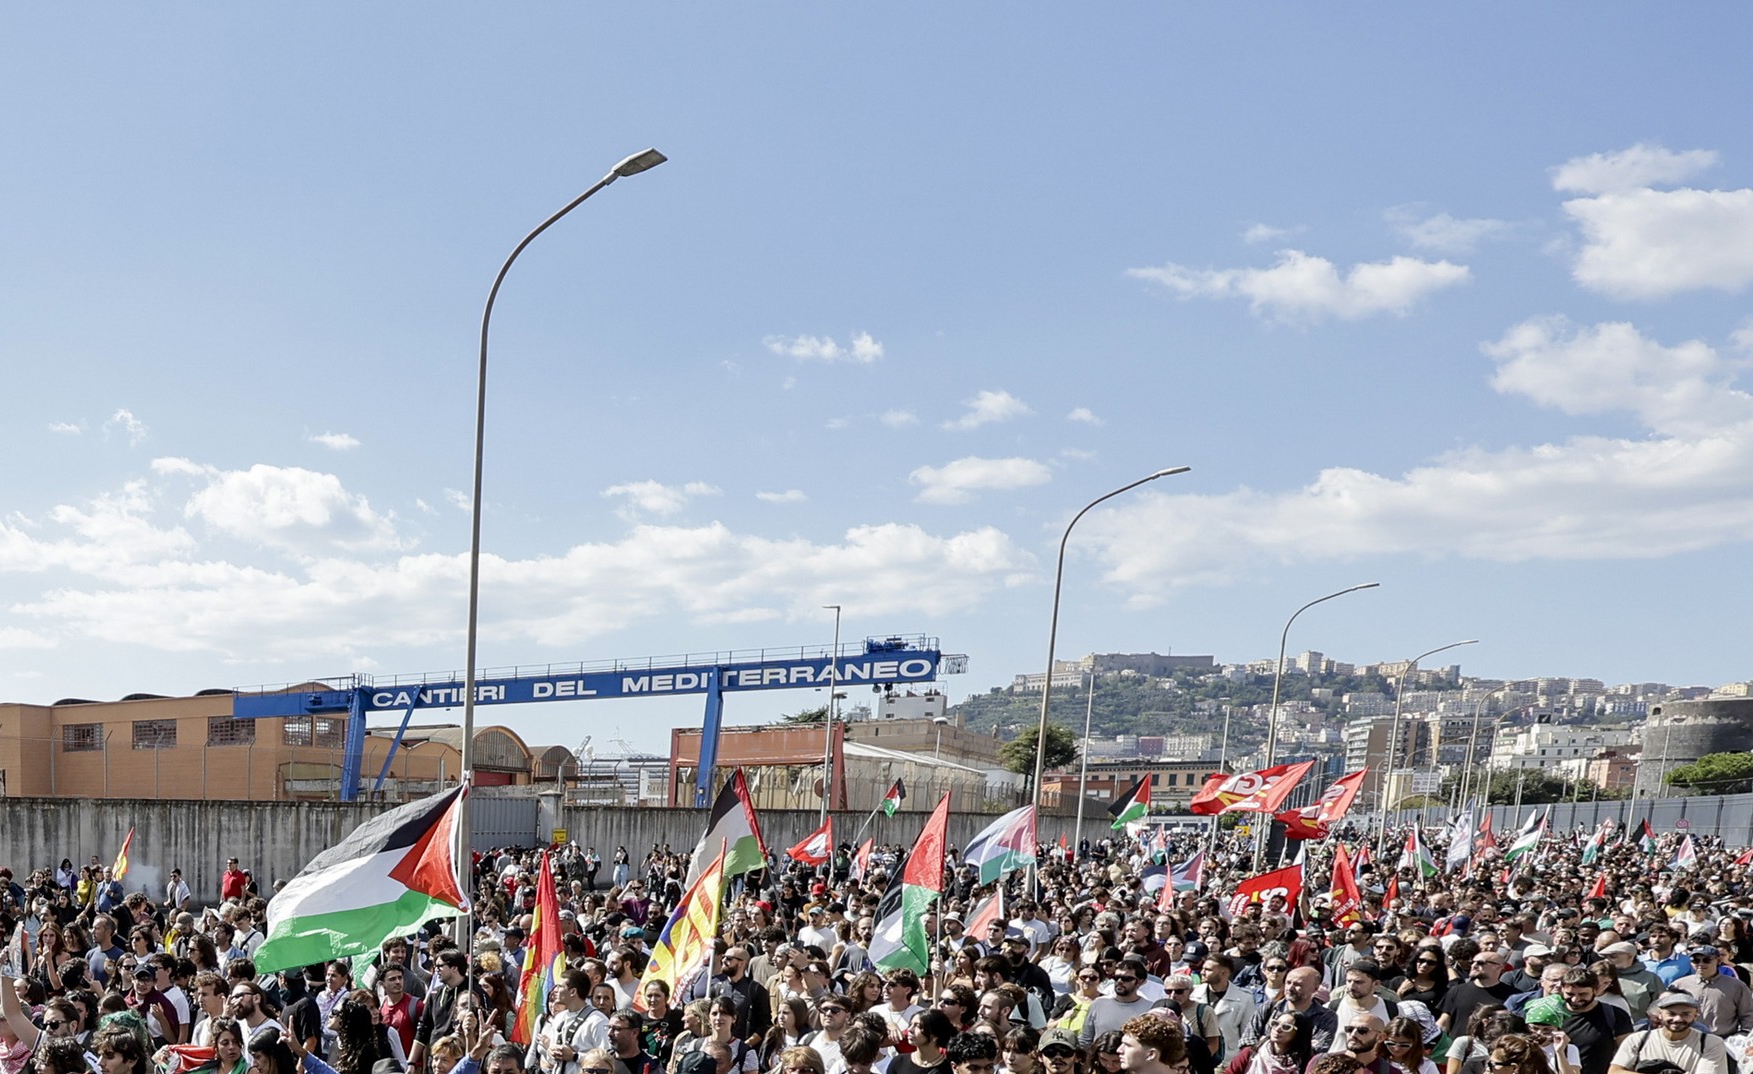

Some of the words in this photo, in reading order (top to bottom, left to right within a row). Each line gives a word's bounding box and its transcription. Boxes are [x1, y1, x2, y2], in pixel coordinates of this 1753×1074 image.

[372, 684, 506, 708] CANTIERI
[533, 679, 597, 698] DEL
[622, 658, 932, 693] MEDITERRANEO
